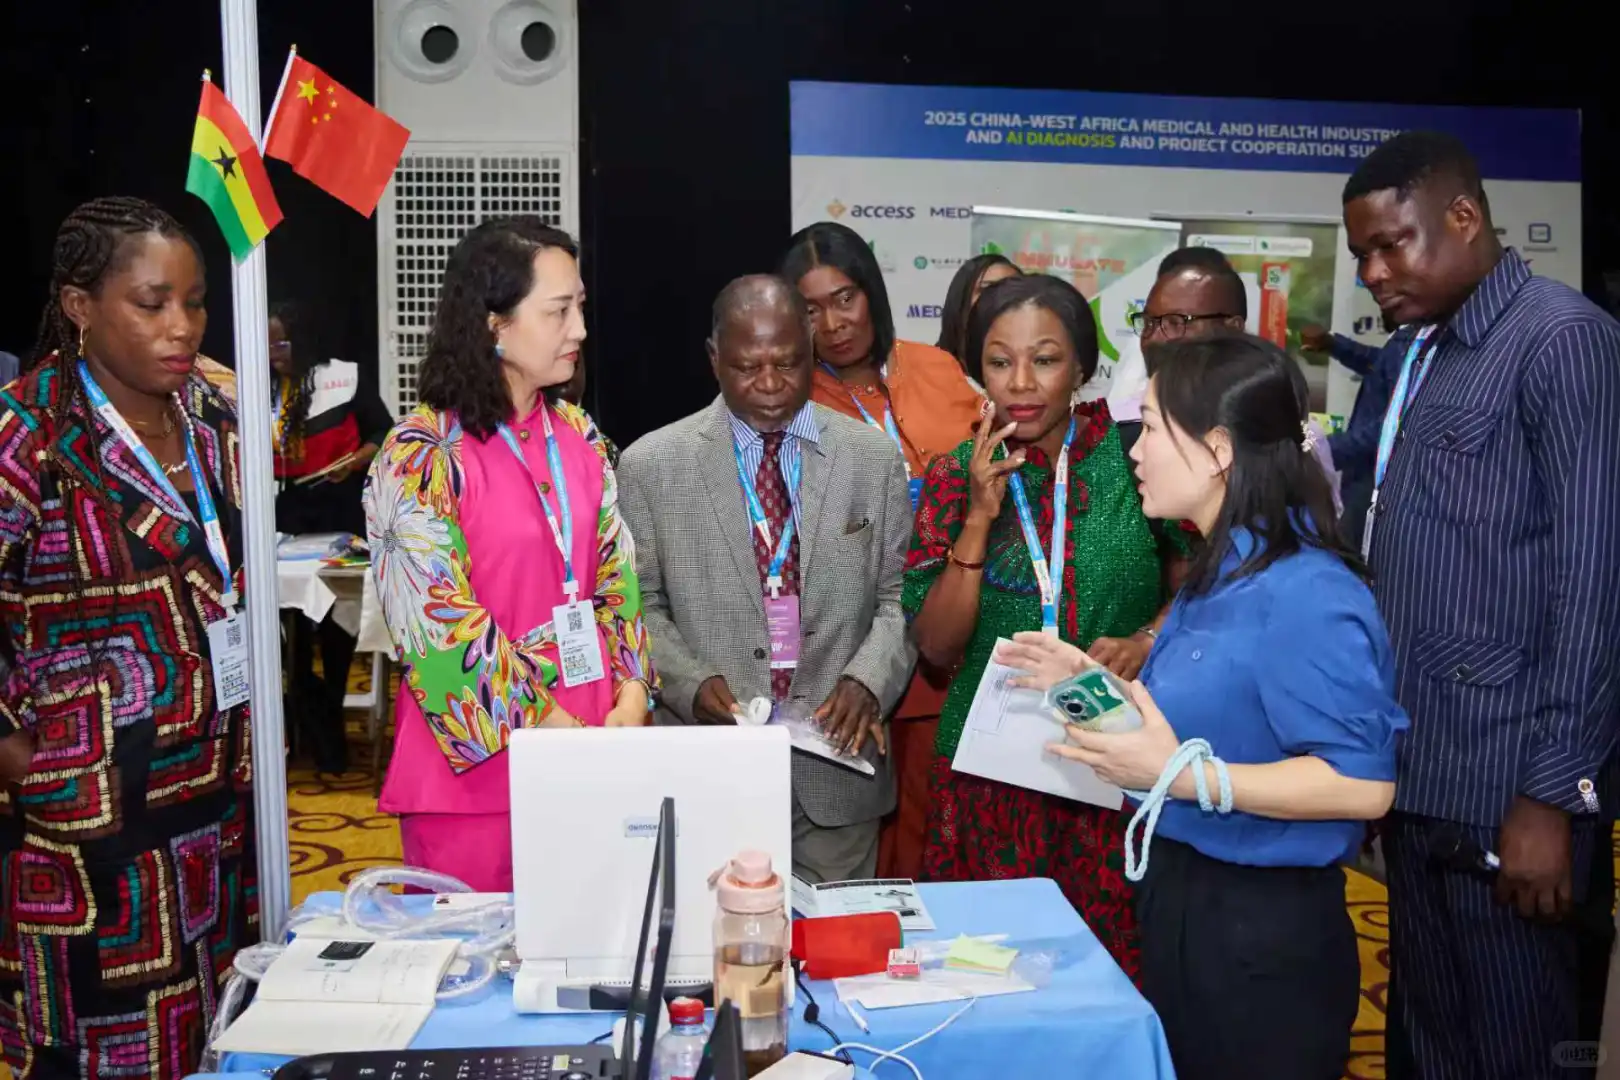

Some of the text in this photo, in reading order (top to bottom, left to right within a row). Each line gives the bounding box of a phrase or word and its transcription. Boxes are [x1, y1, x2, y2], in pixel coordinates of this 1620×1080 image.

[924, 111, 967, 126] 2025
[970, 113, 1077, 130] CHINA-WEST
[1079, 116, 1139, 132] AFRICA
[1142, 119, 1215, 135] MEDICAL
[1218, 122, 1254, 137] AND
[1257, 124, 1319, 140] HEALTH
[966, 129, 1002, 144] AND
[1006, 131, 1023, 145] AI
[1027, 132, 1116, 148] DIAGNOSIS
[1120, 135, 1155, 150] AND
[1158, 137, 1228, 153] PROJECT
[1231, 140, 1345, 158] COOPERATION
[851, 204, 916, 219] access
